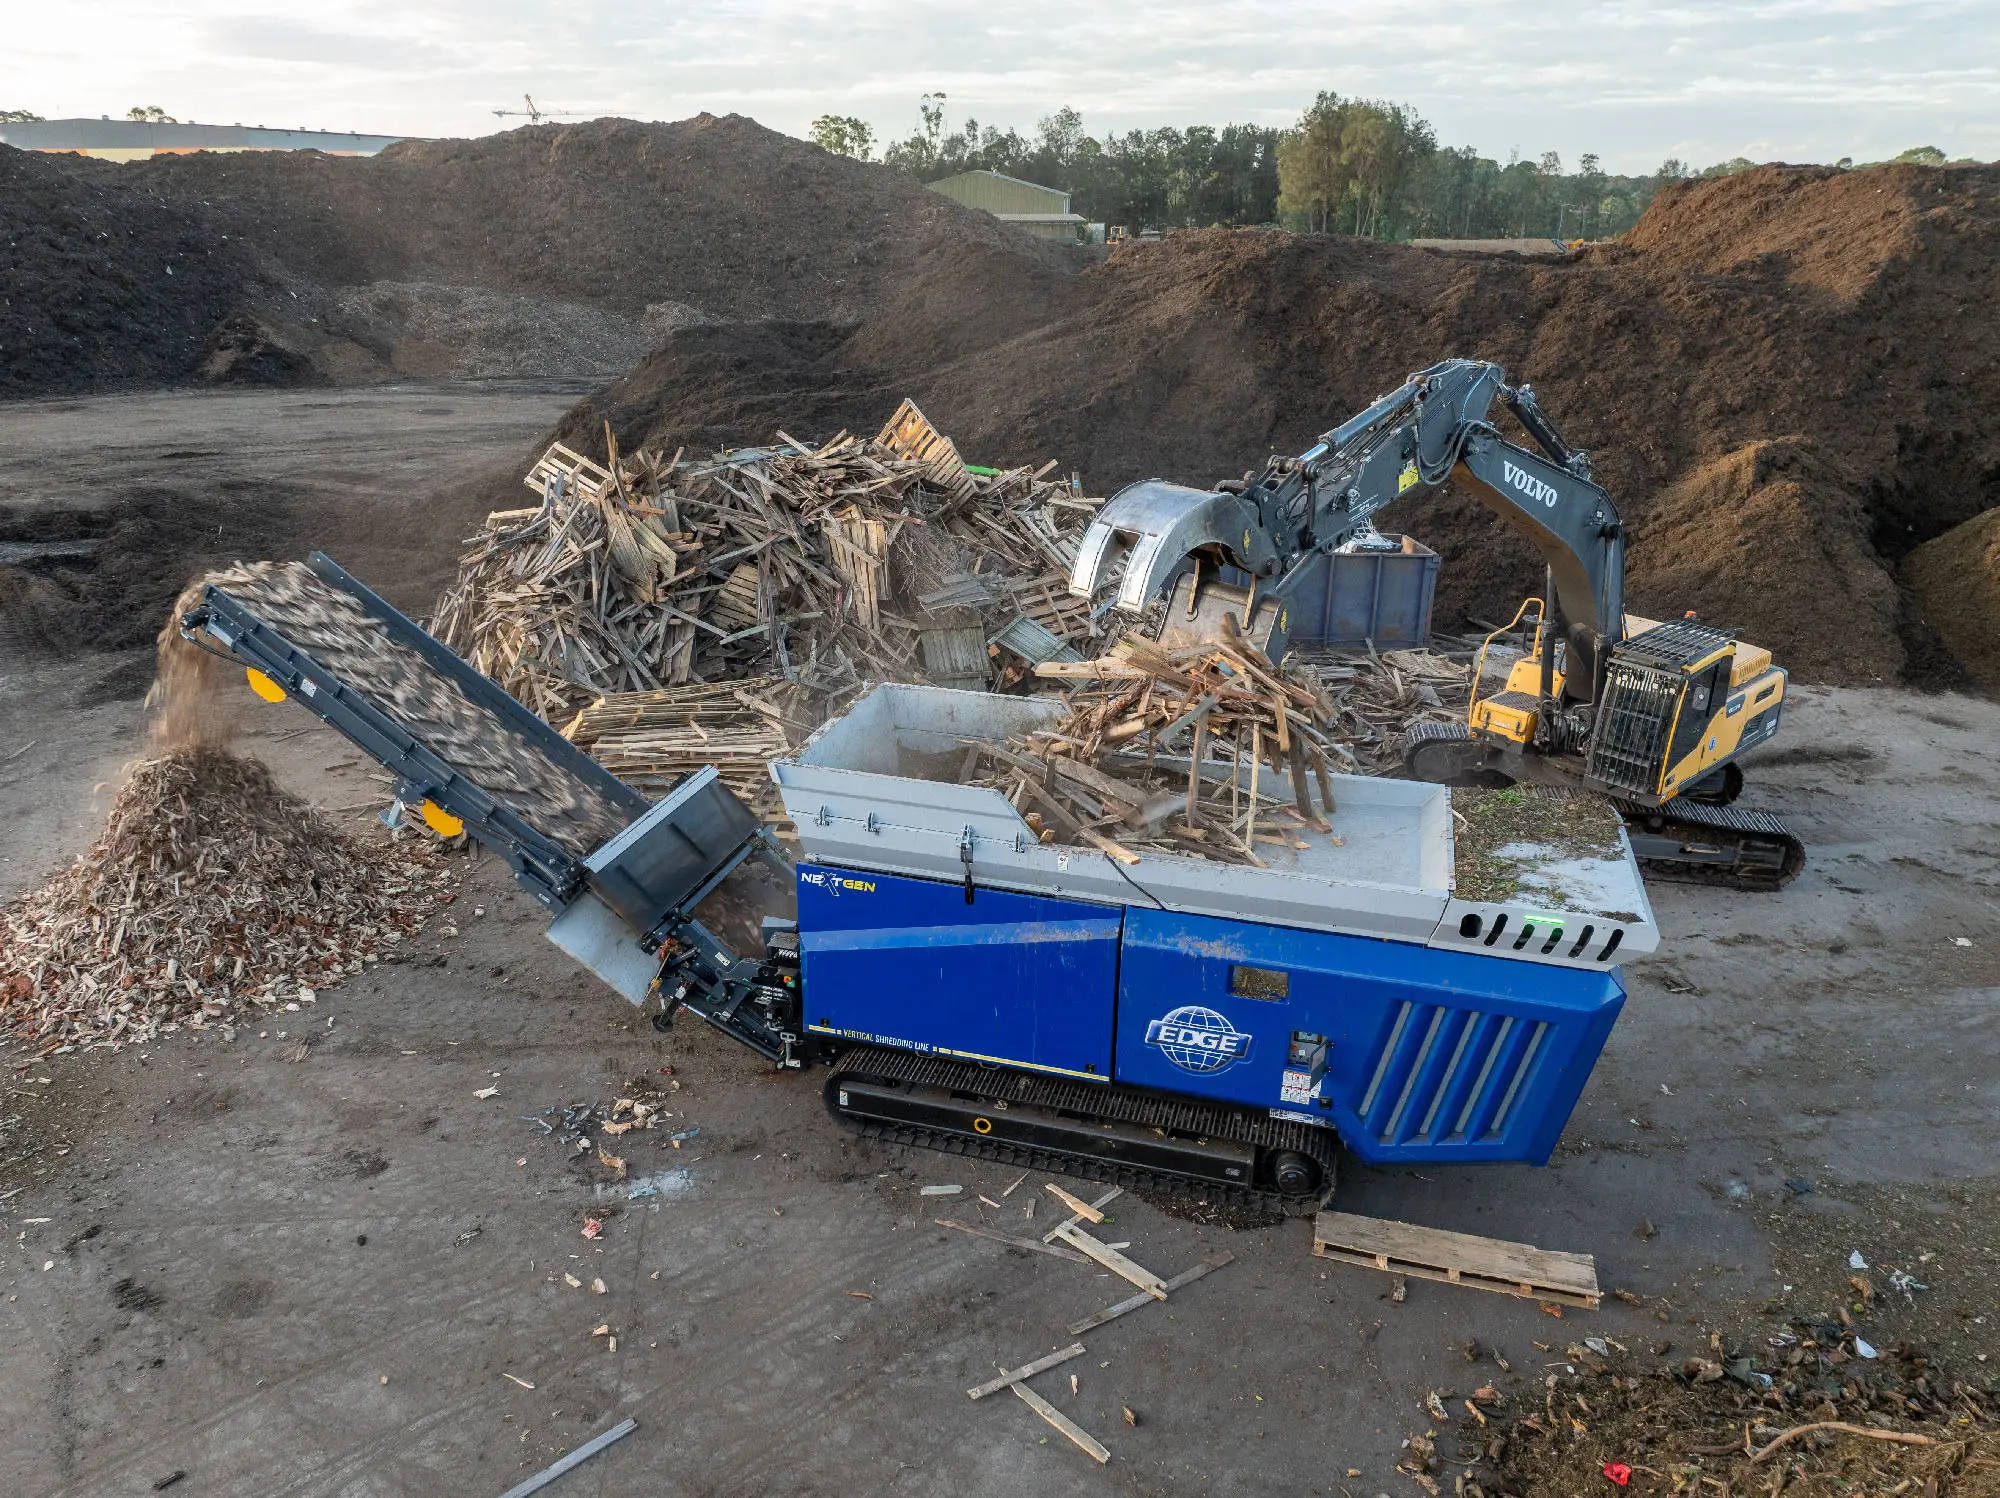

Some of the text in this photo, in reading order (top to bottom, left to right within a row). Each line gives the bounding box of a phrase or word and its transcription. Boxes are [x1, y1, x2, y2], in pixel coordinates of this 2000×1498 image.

[1503, 461, 1557, 507] VOLVO
[843, 1028, 930, 1052] VERTICAL SHREDDING LINE
[1158, 1025, 1239, 1052] EDGE
